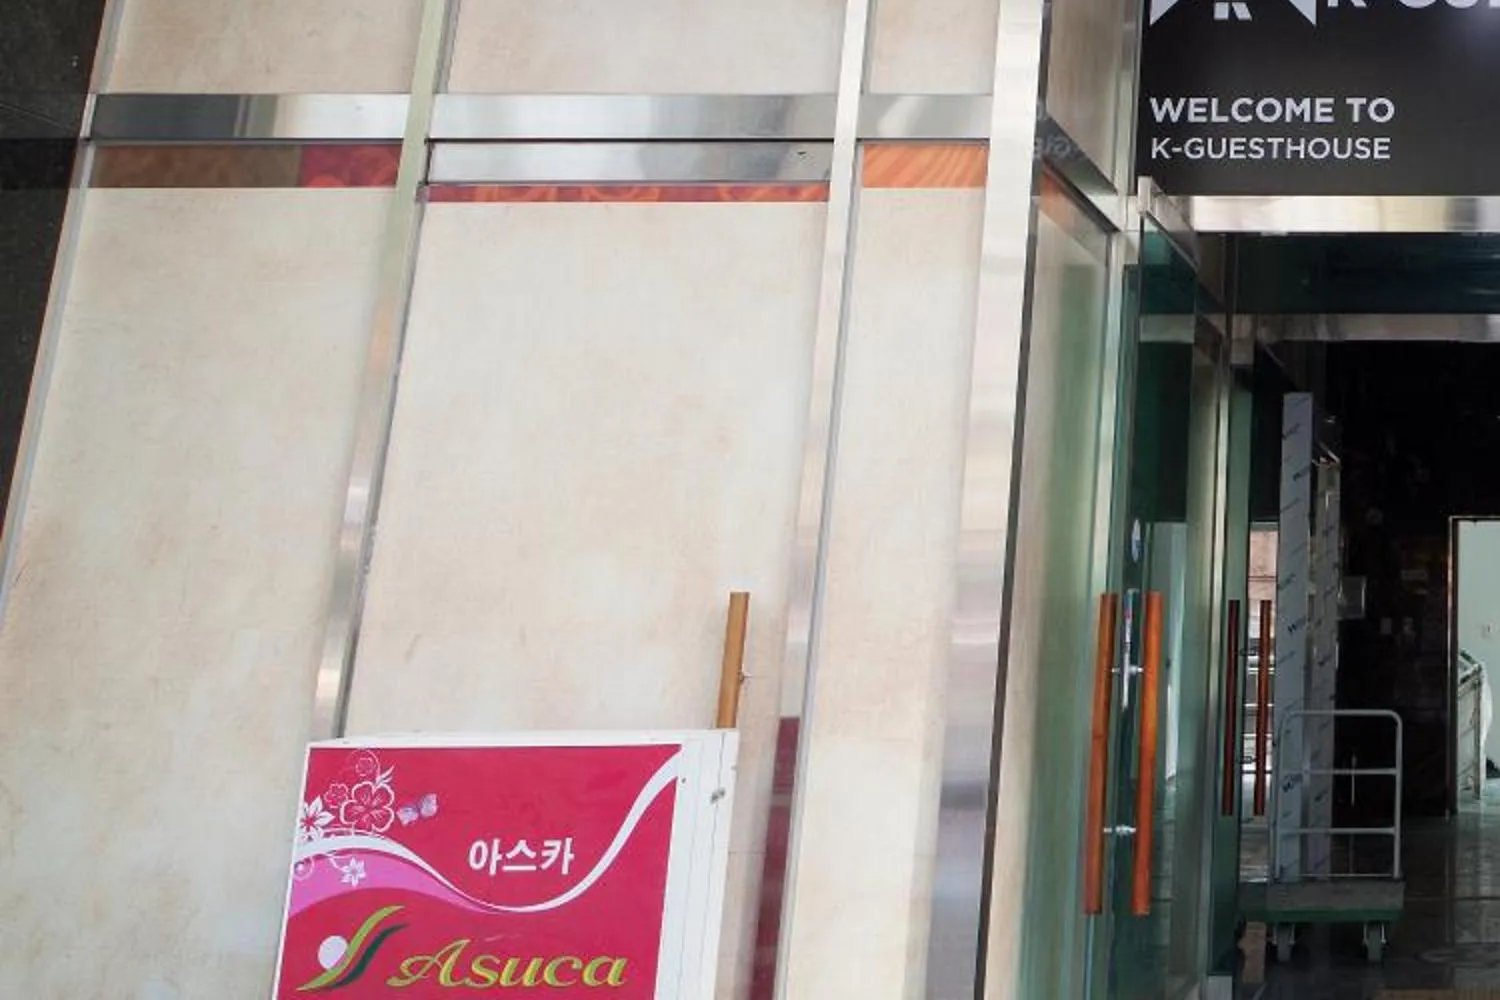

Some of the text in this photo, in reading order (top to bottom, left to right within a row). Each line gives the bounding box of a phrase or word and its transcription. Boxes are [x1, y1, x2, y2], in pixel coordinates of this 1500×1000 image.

[1149, 96, 1396, 124] WELCOME TO
[1150, 136, 1391, 160] K-GUESTHOUSE
[467, 836, 576, 877] 아스카
[386, 938, 629, 989] Asuca
